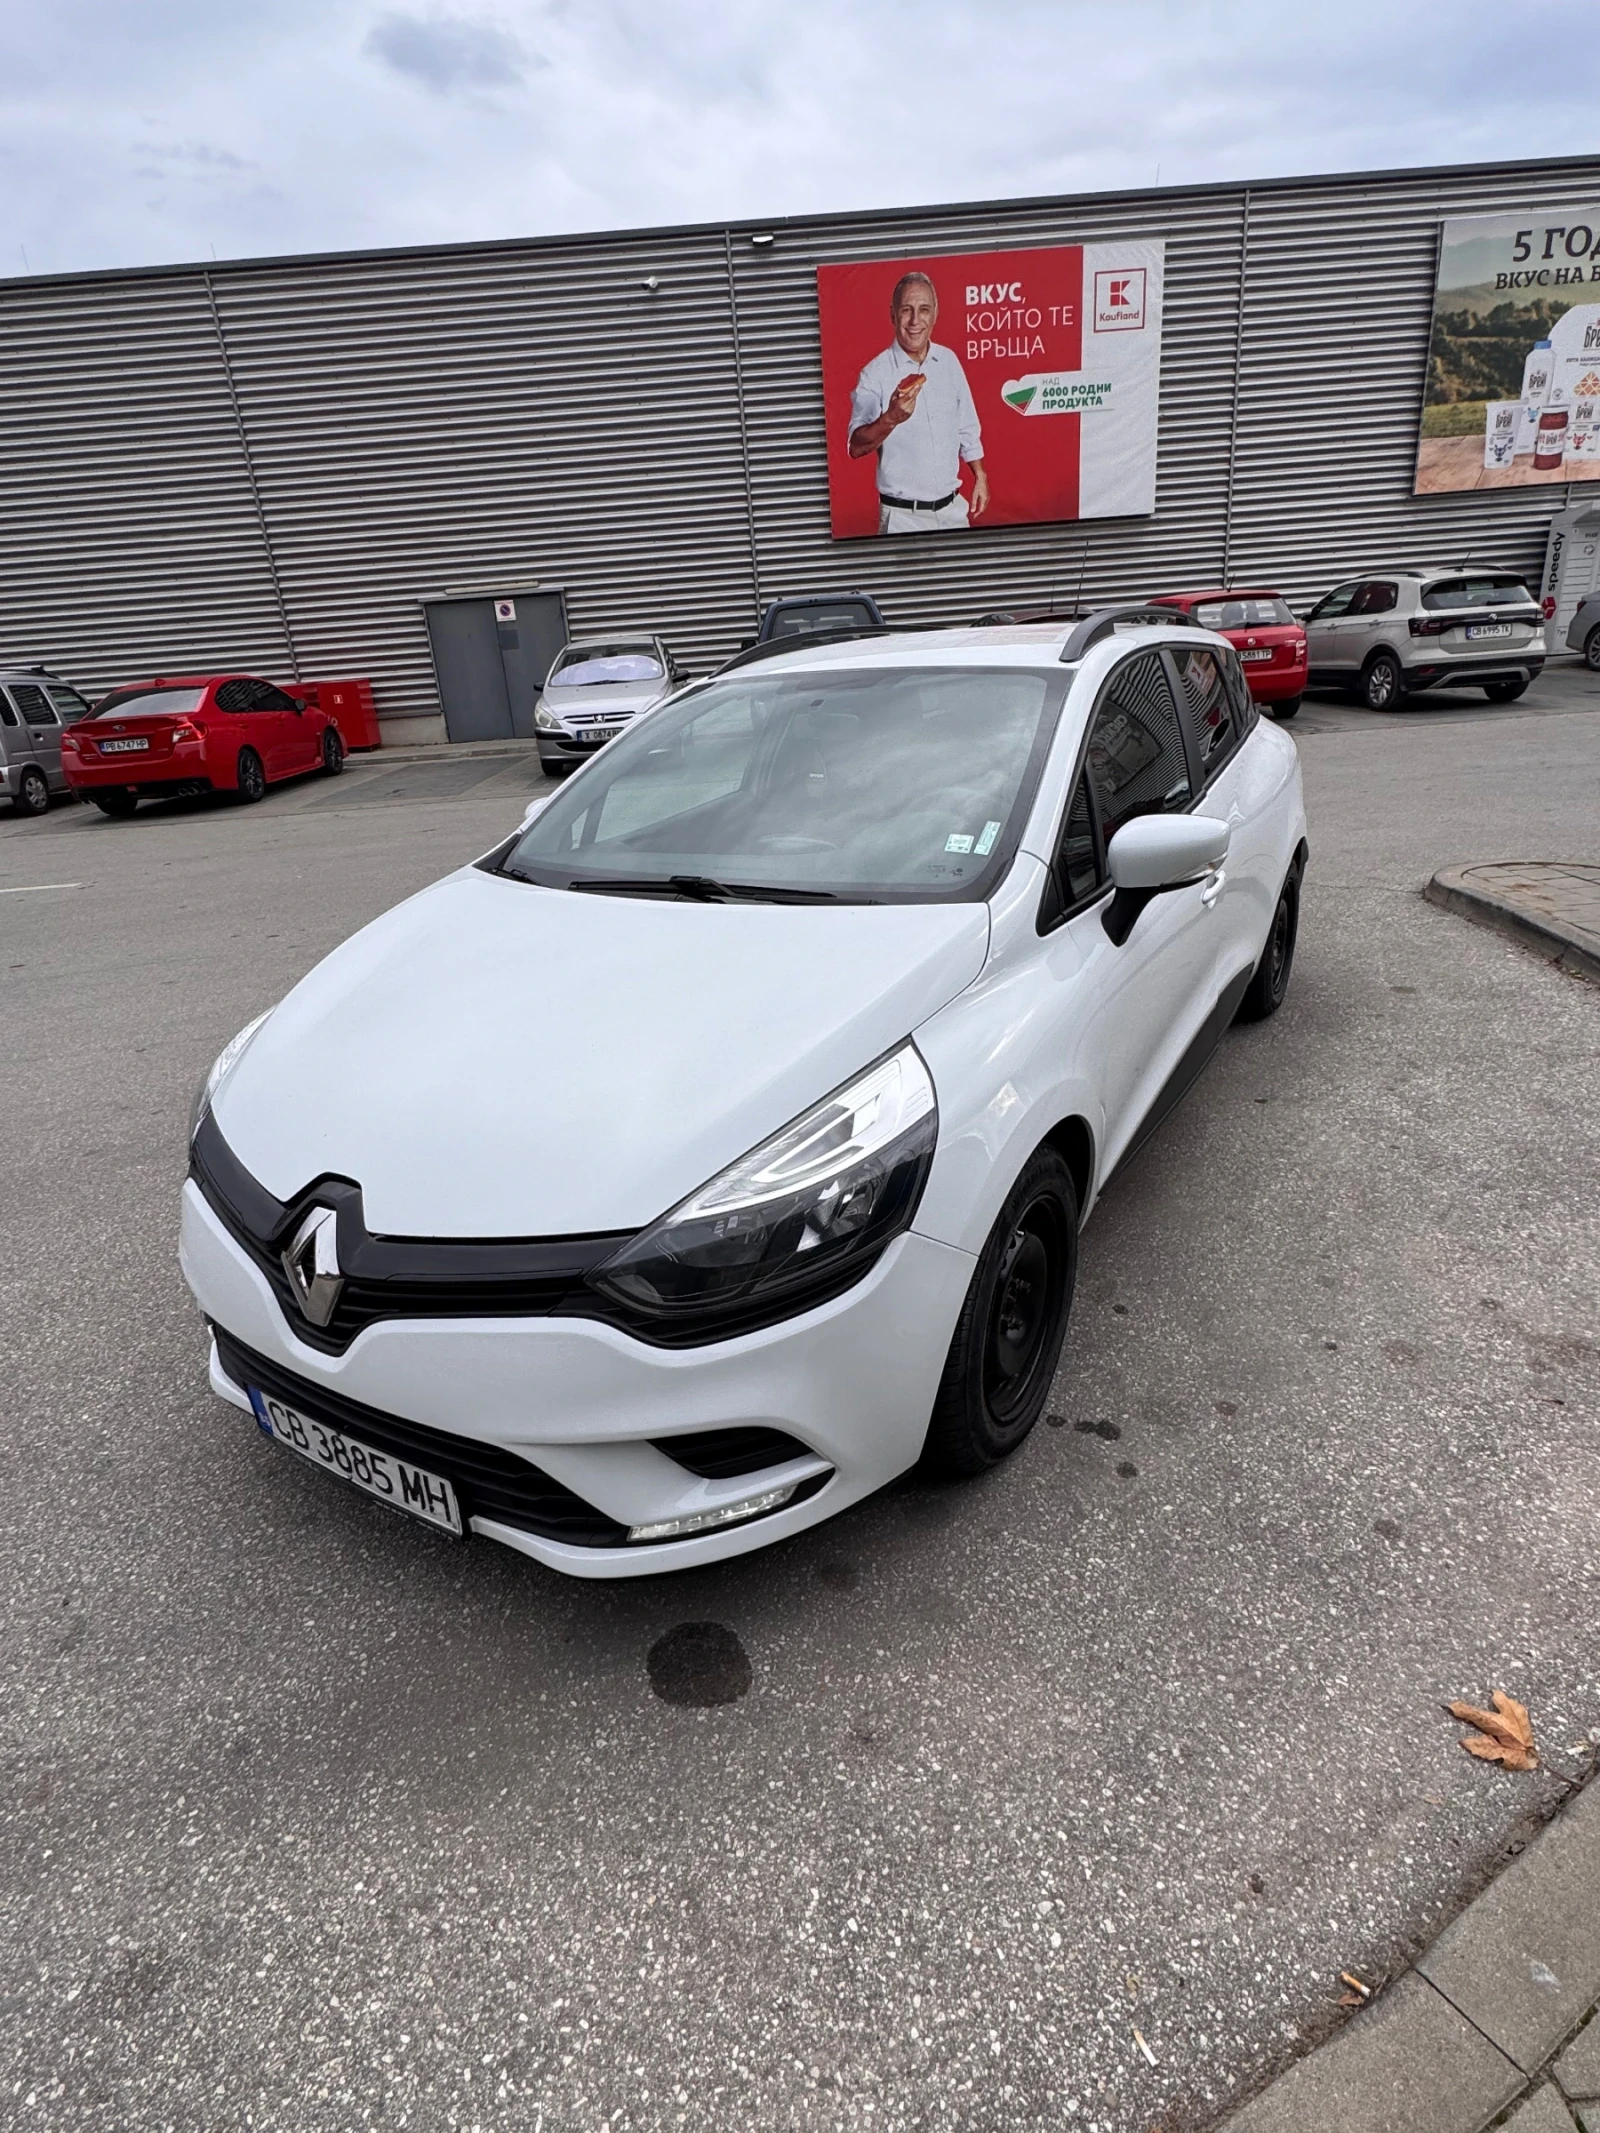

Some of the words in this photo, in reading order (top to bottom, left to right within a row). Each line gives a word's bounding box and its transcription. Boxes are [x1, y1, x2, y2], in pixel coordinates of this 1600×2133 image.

[1512, 230, 1533, 262] 5
[1495, 269, 1550, 290] ВКУС
[1554, 266, 1584, 285] НА
[965, 282, 1026, 306] ВКУС,
[966, 307, 1042, 333] КОЙТО
[1049, 306, 1073, 326] ТЕ
[1100, 310, 1140, 322] Kaufland
[967, 335, 1045, 360] ВРЪЩА
[1042, 377, 1060, 385] НАД
[1042, 386, 1069, 397] 6000
[1071, 383, 1112, 396] РОДНИ
[1042, 396, 1103, 410] ПРОДУКТА
[1548, 532, 1566, 592] speedy
[105, 742, 116, 751] PB
[117, 740, 135, 749] 6747
[136, 739, 146, 748] HP
[268, 1401, 309, 1450] CB
[312, 1424, 393, 1494] 3885
[398, 1463, 451, 1522] MH
